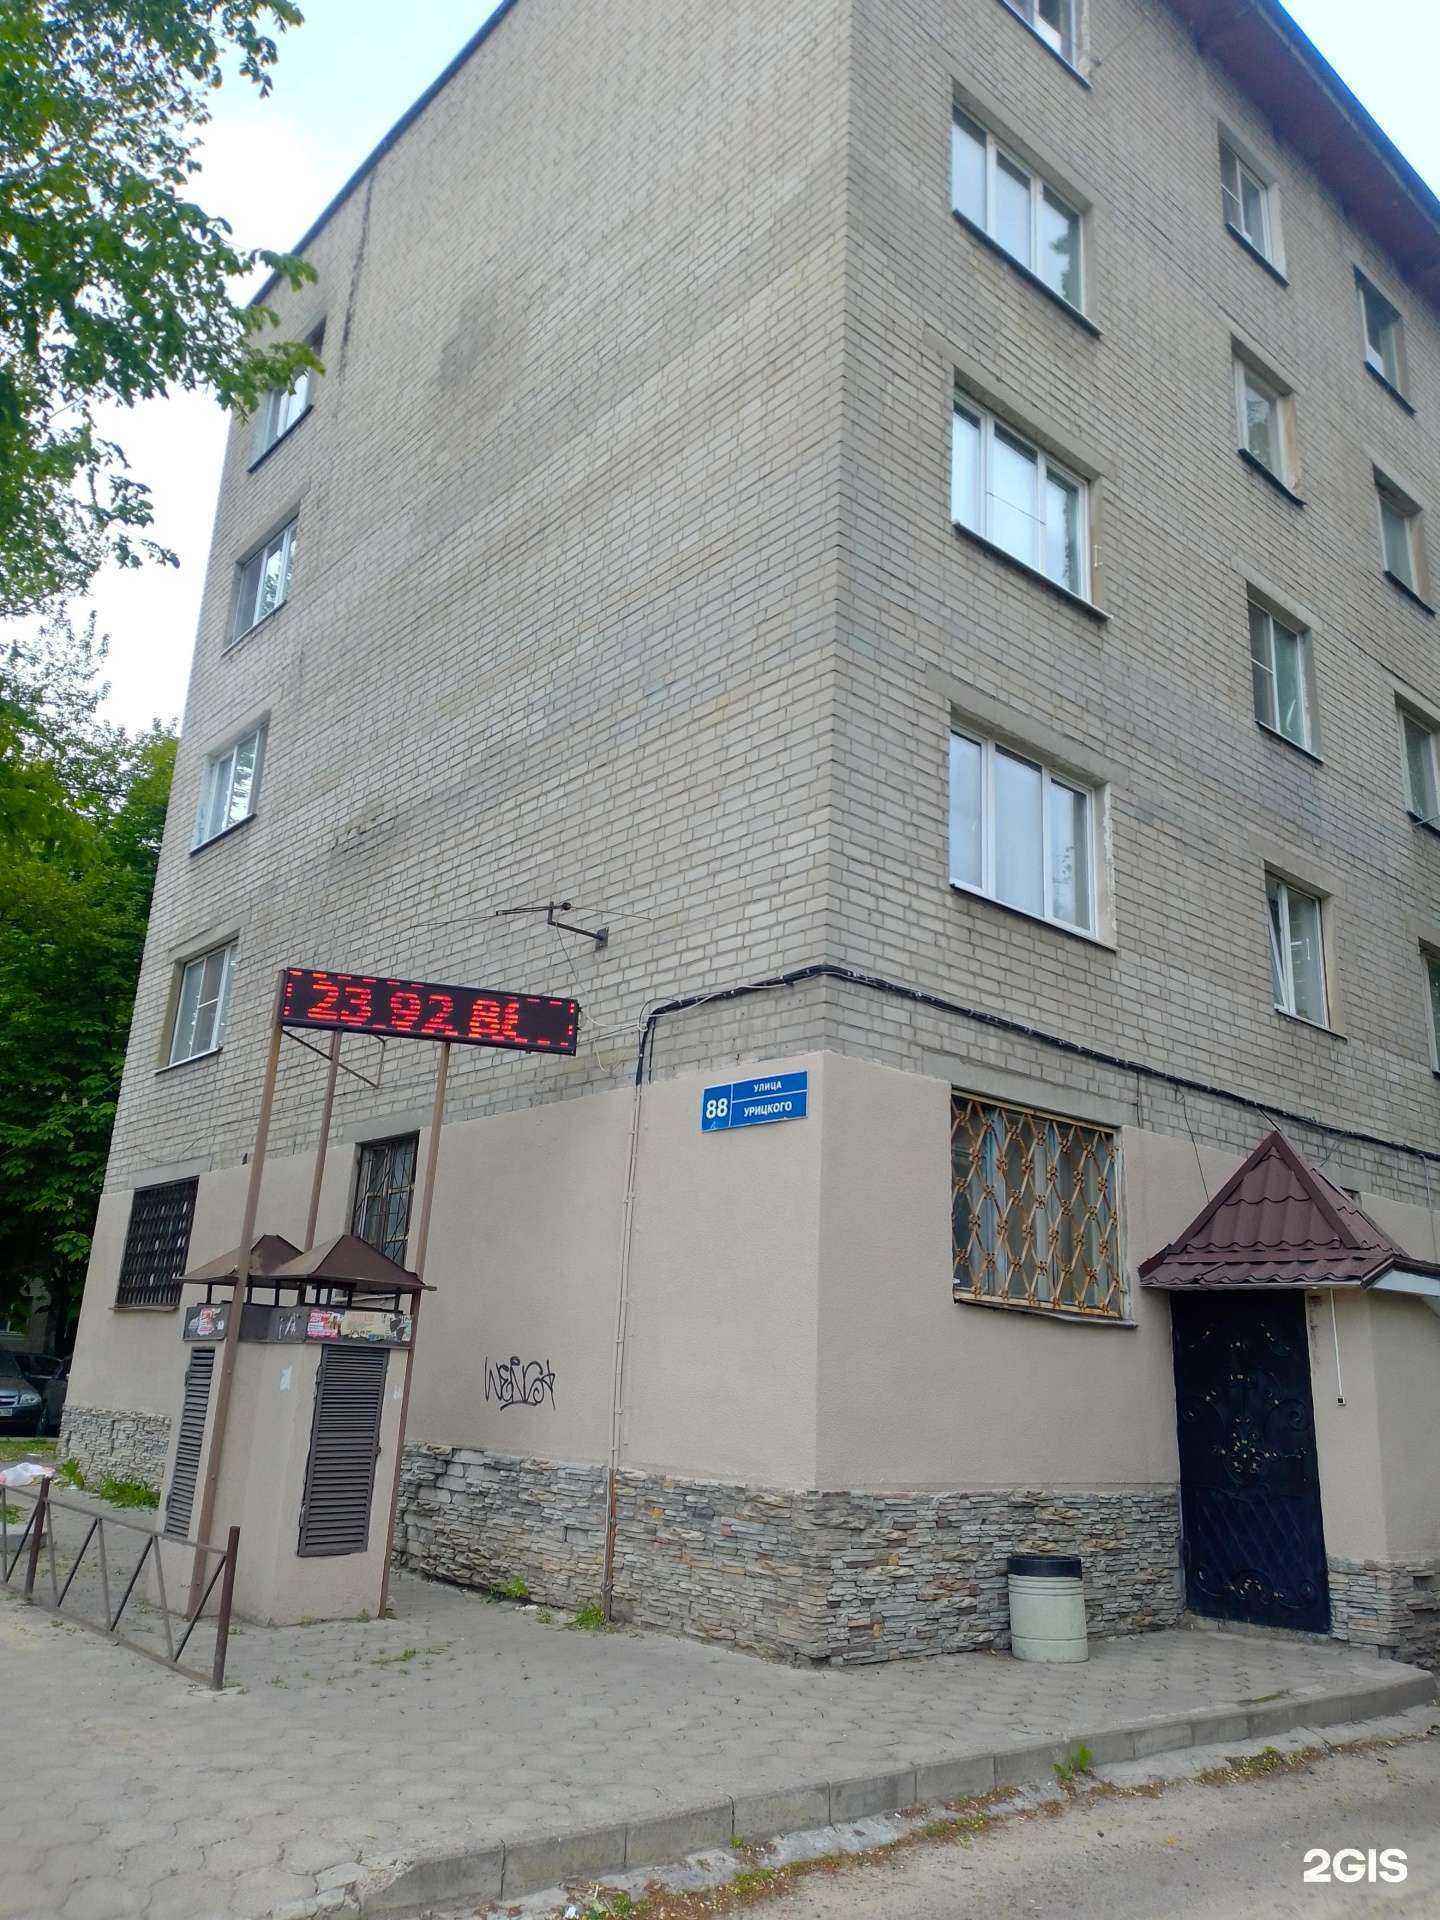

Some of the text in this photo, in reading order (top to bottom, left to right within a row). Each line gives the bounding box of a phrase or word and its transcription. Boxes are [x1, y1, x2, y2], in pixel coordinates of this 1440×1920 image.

[307, 980, 372, 1025] 23
[753, 1080, 782, 1093] УЛИЦА
[705, 1097, 729, 1119] 88
[743, 1100, 792, 1118] УРИЦКОГО
